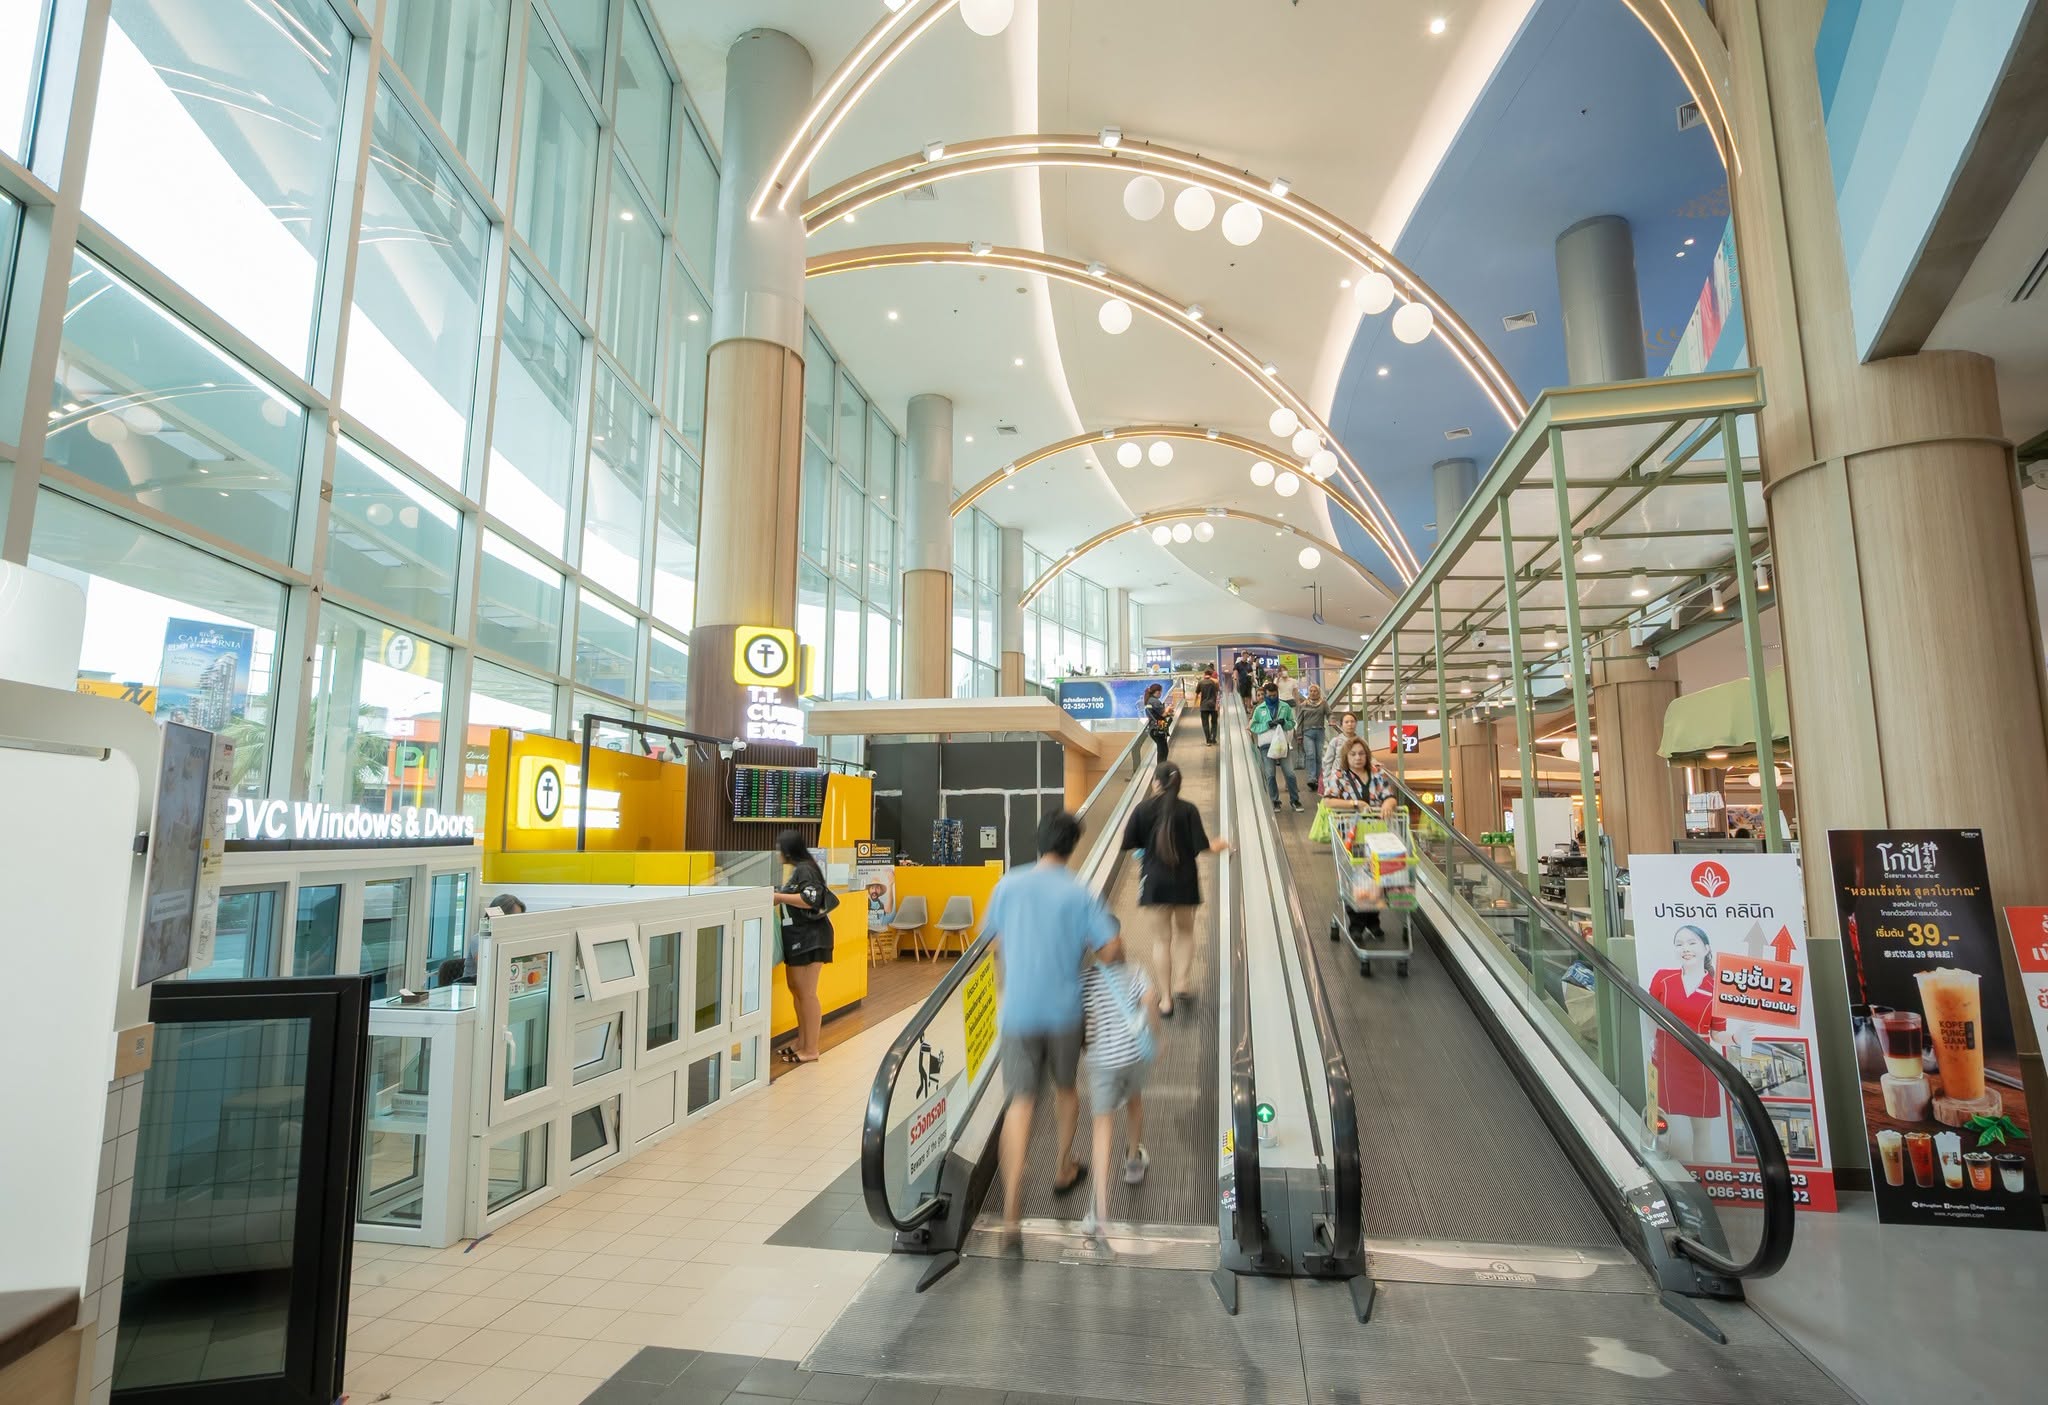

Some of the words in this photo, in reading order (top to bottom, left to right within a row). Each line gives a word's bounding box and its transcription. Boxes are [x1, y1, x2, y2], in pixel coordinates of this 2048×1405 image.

[178, 634, 241, 649] CALIFORNIA
[226, 798, 288, 839] PVC
[294, 802, 401, 839] Windows
[405, 806, 420, 838] &
[425, 808, 474, 838] Doors
[1654, 903, 1718, 919] ปาริชาติ
[1725, 903, 1775, 919] คลินิก
[1876, 924, 1904, 938] เริ่มต้น
[1907, 923, 1960, 947] 39.-
[1721, 965, 1774, 992] อยู่ชั้น
[1779, 976, 1793, 993] 2
[1720, 990, 1760, 1007] ตรงข้าม
[1761, 997, 1797, 1014] โฮมโปร
[910, 1097, 946, 1146] ระวังกระจก
